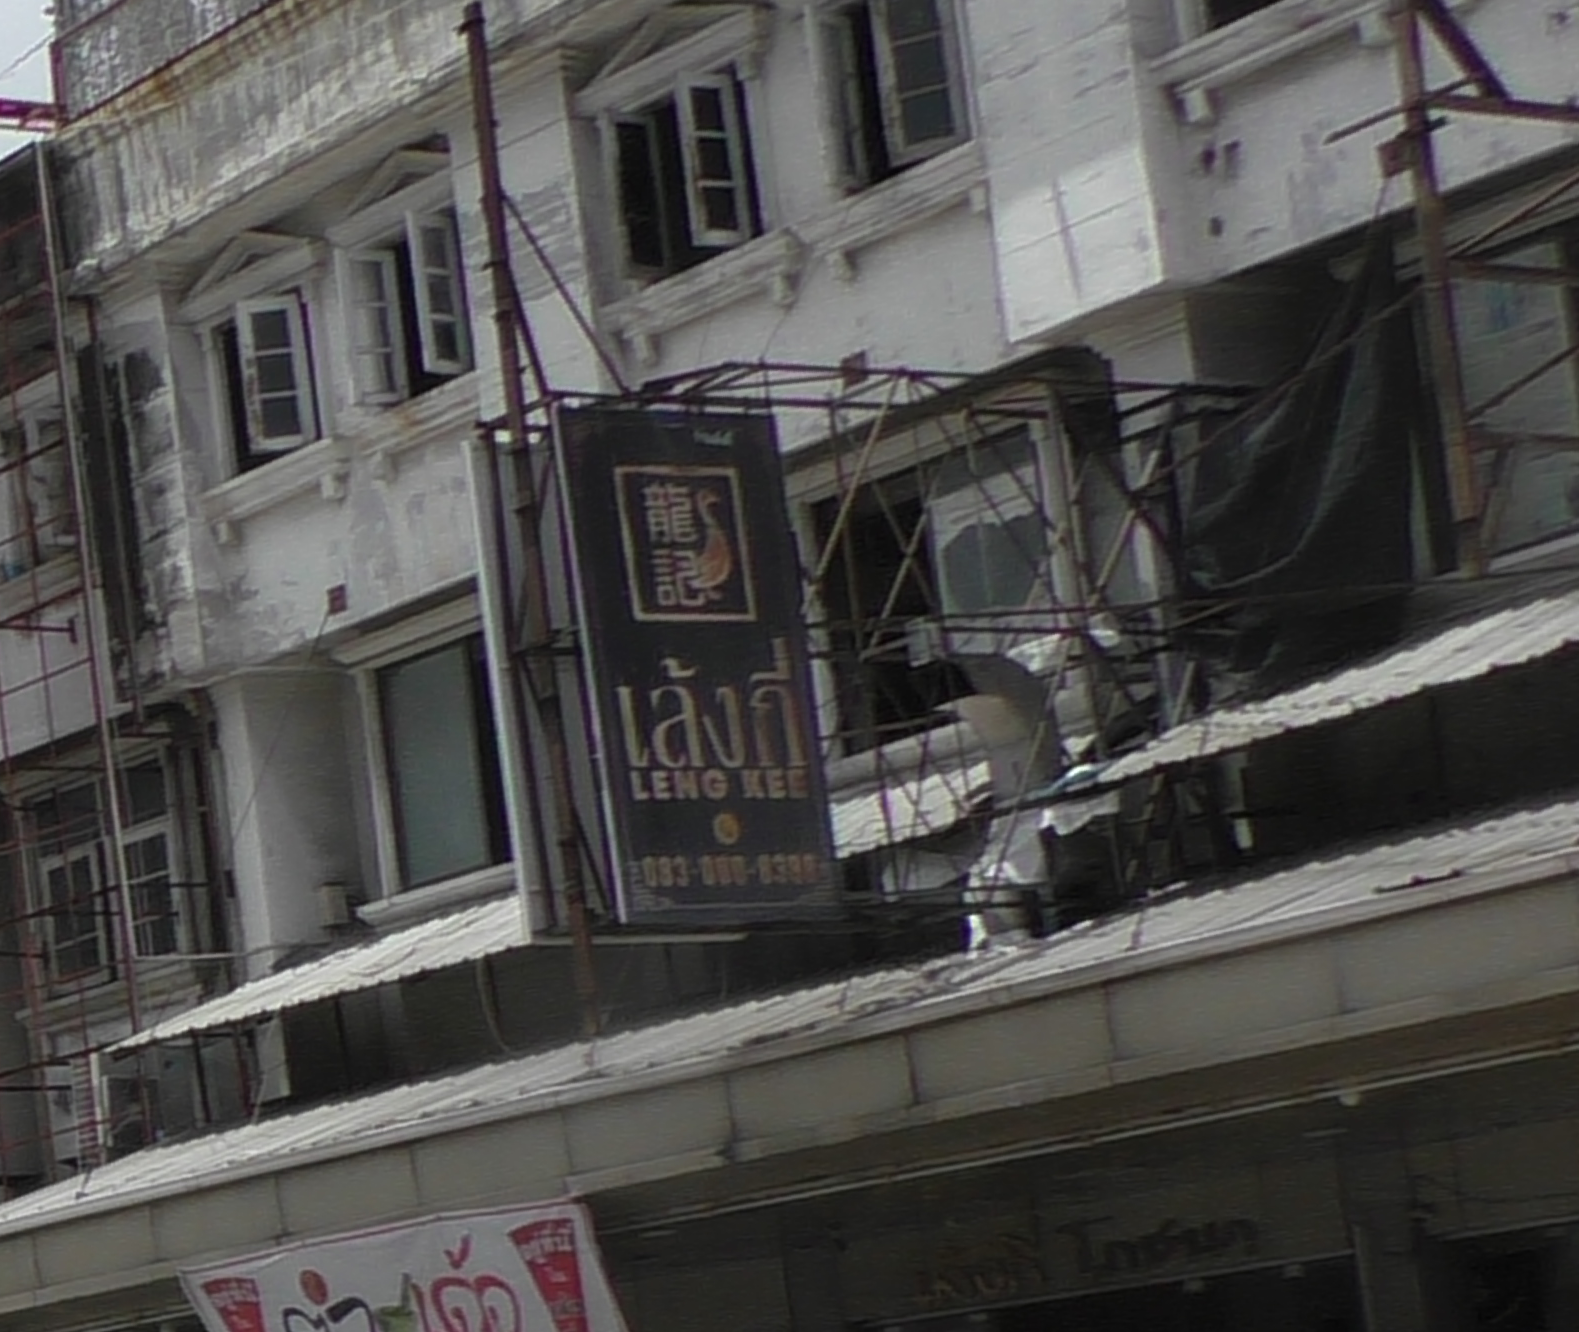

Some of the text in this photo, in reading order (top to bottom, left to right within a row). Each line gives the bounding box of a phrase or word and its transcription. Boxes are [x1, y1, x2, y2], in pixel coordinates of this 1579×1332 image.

[644, 481, 708, 608] 龍記
[632, 767, 809, 801] LENG KEE
